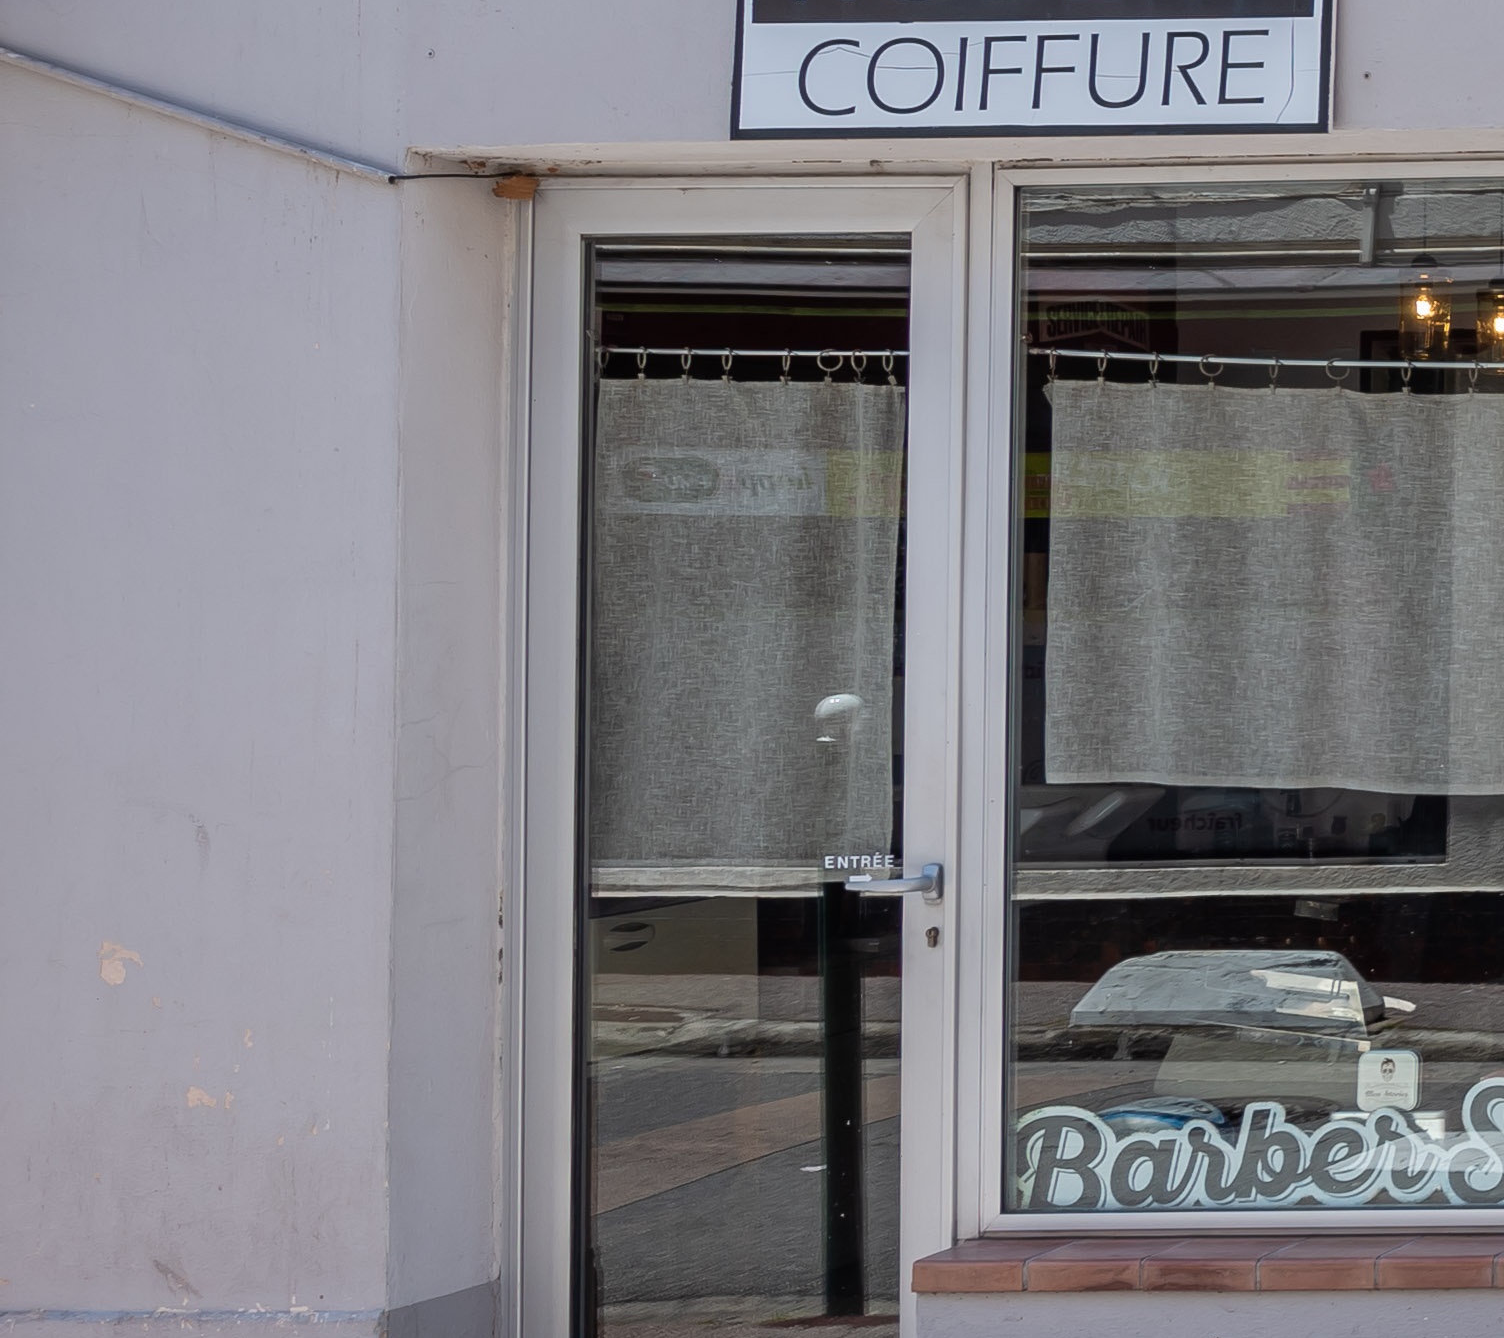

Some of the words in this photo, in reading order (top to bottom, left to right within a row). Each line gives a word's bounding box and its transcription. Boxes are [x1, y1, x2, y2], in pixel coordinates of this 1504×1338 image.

[798, 30, 1270, 116] COIFFURE
[824, 852, 895, 869] ENTRÉE
[1016, 1102, 1448, 1210] Barber
